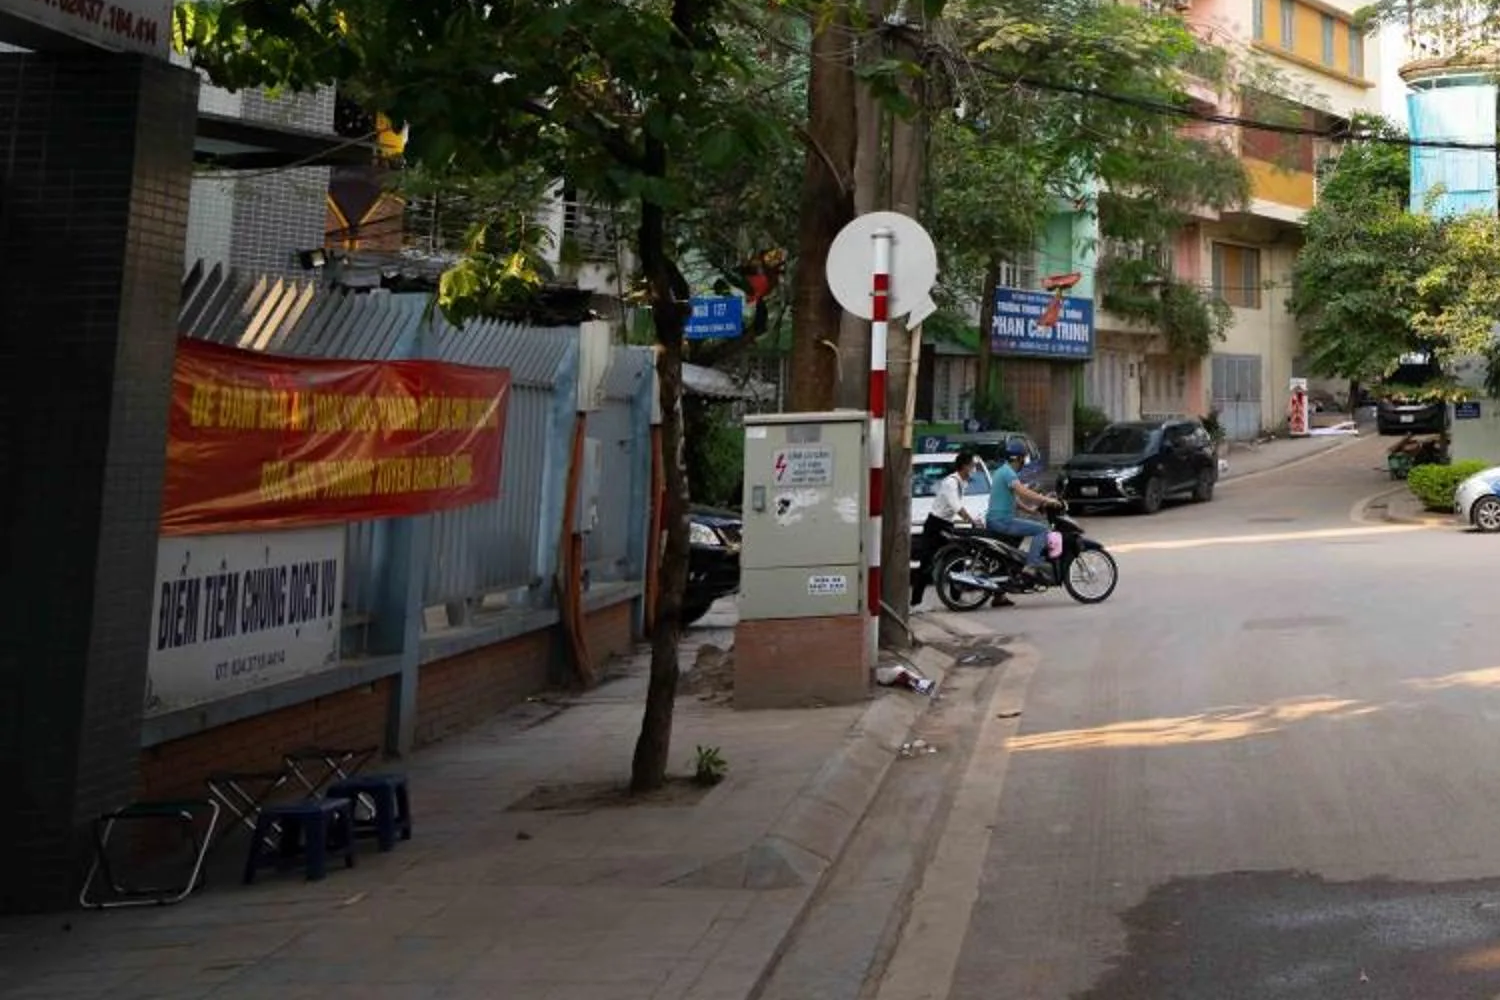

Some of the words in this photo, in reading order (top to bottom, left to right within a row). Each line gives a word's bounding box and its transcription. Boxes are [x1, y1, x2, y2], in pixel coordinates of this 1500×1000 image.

[203, 559, 240, 642] TIÊM
[288, 560, 320, 638] DỊCH
[321, 559, 337, 631] VỤ
